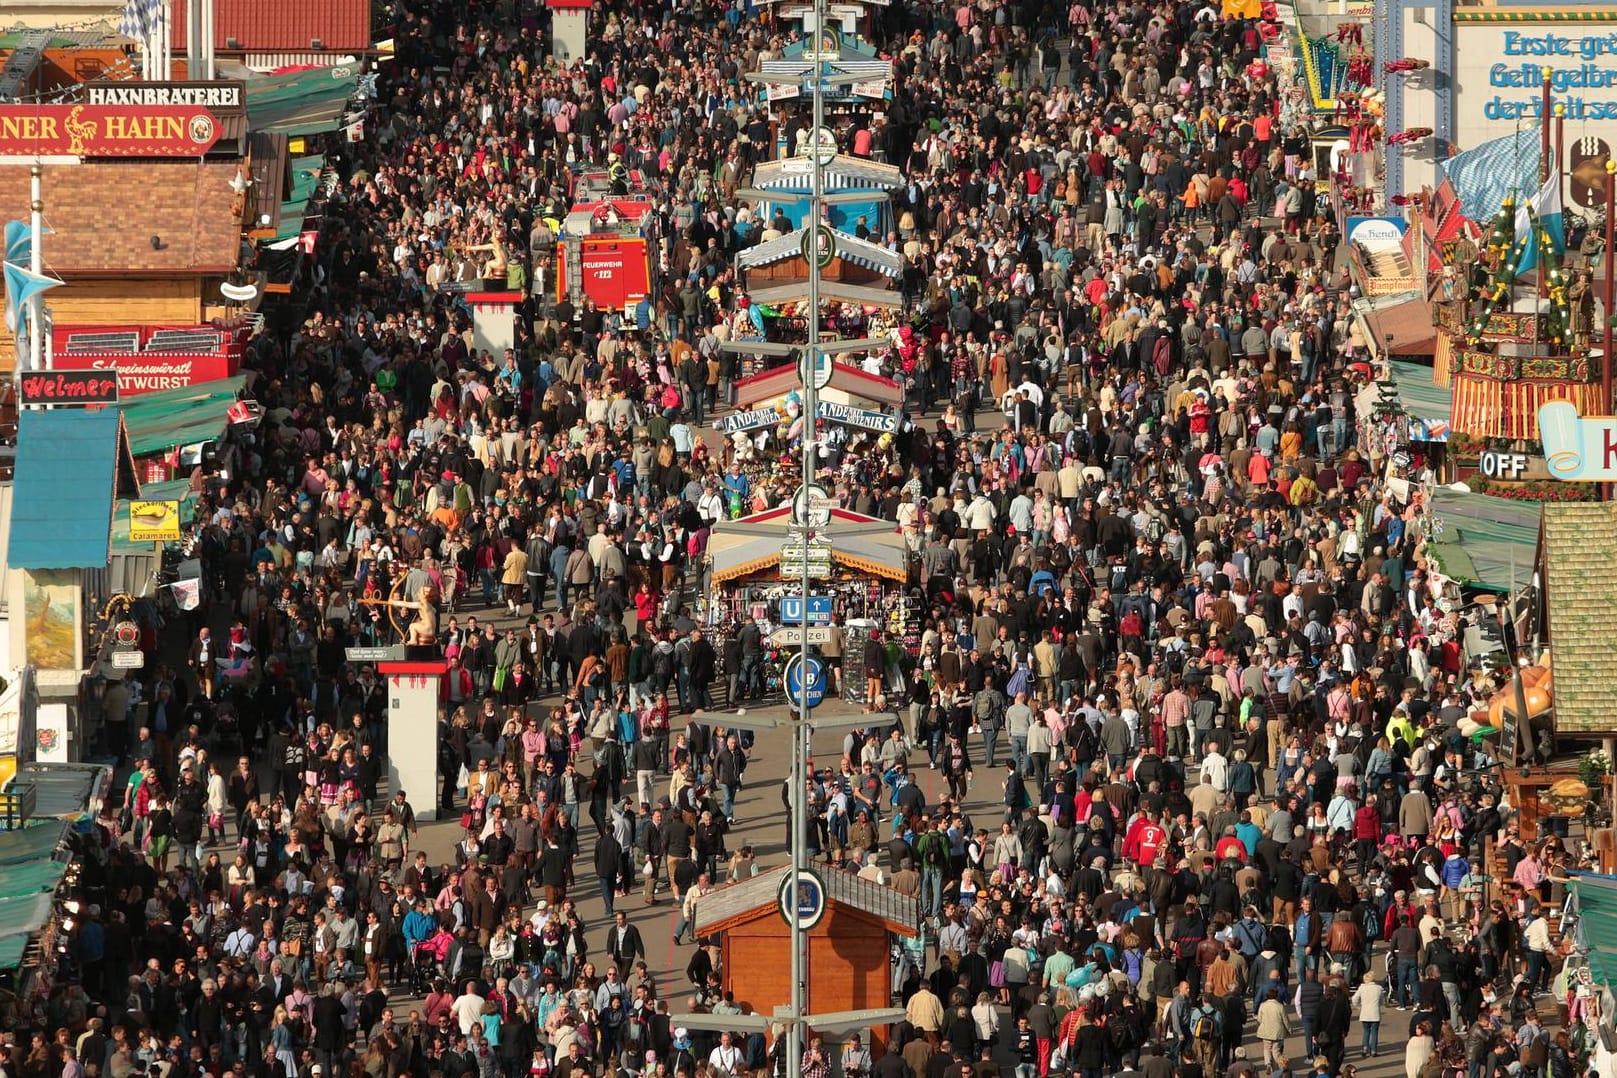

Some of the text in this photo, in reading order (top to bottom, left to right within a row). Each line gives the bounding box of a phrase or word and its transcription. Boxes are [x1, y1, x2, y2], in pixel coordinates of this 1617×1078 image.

[1503, 31, 1569, 56] Erste
[89, 87, 240, 106] HAXNBRATEREI
[1484, 95, 1528, 120] der
[1530, 95, 1585, 120] Wlt
[0, 116, 185, 140] NER HAHN
[599, 270, 613, 279] 112
[786, 602, 799, 618] U
[787, 631, 825, 641] Pozei
[794, 691, 821, 699] MCHEN
[1147, 830, 1154, 843] 9
